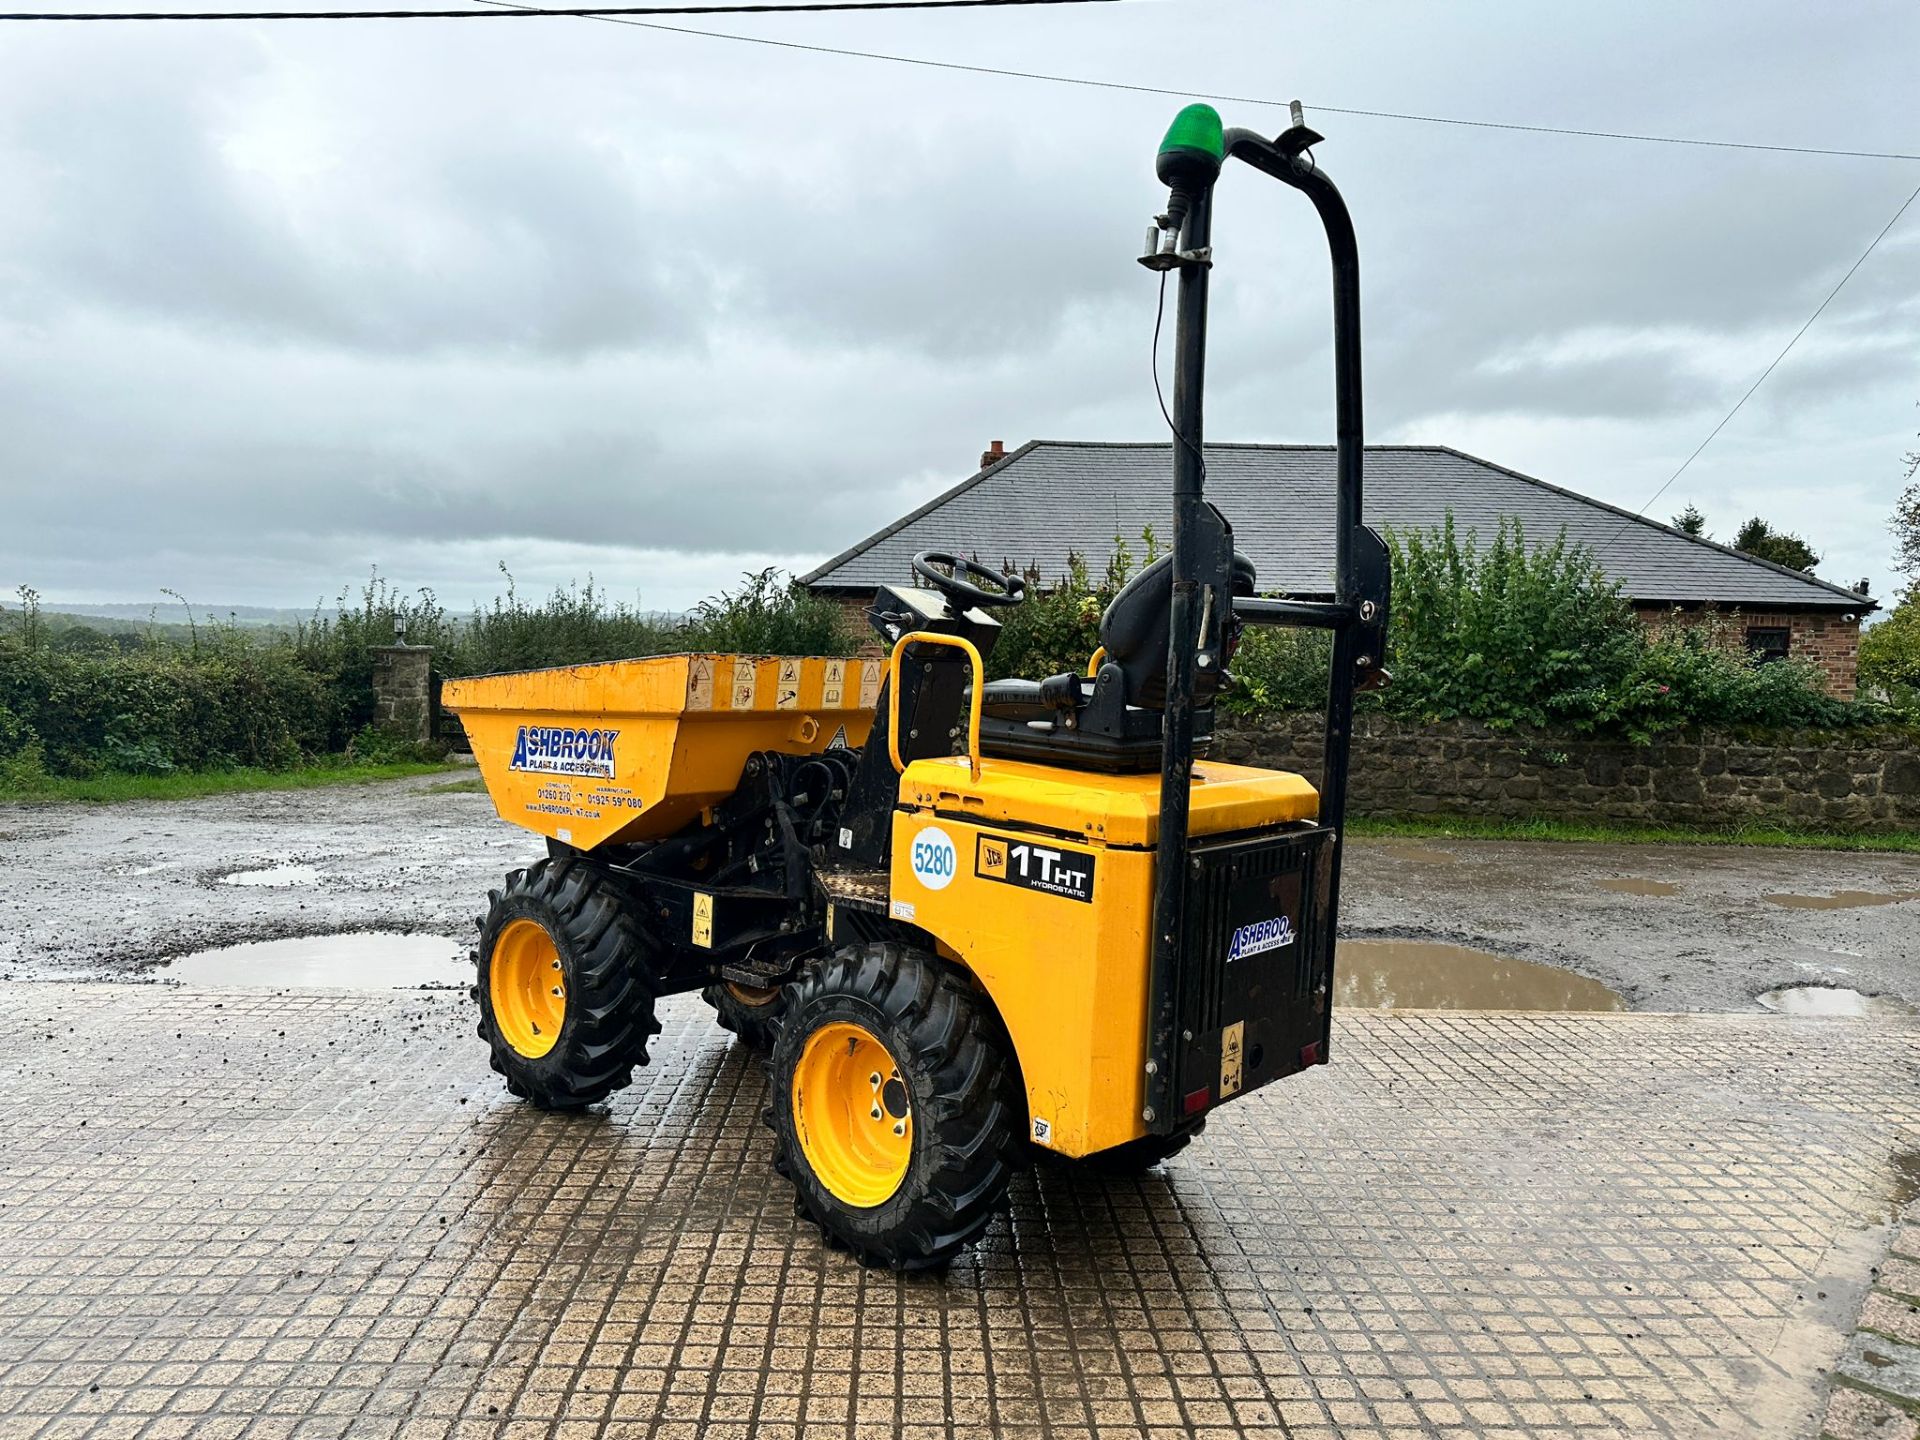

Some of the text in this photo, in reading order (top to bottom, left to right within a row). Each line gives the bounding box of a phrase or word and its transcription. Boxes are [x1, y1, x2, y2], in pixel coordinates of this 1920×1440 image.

[511, 728, 616, 767] ASHBROOK
[552, 761, 558, 770] &
[538, 789, 557, 801] 01260
[915, 843, 953, 877] 5280
[986, 847, 1003, 866] JCB
[1031, 880, 1086, 897] HYDROSTATIC
[1228, 917, 1290, 959] ASHBROO
[1241, 945, 1256, 956] PLANT
